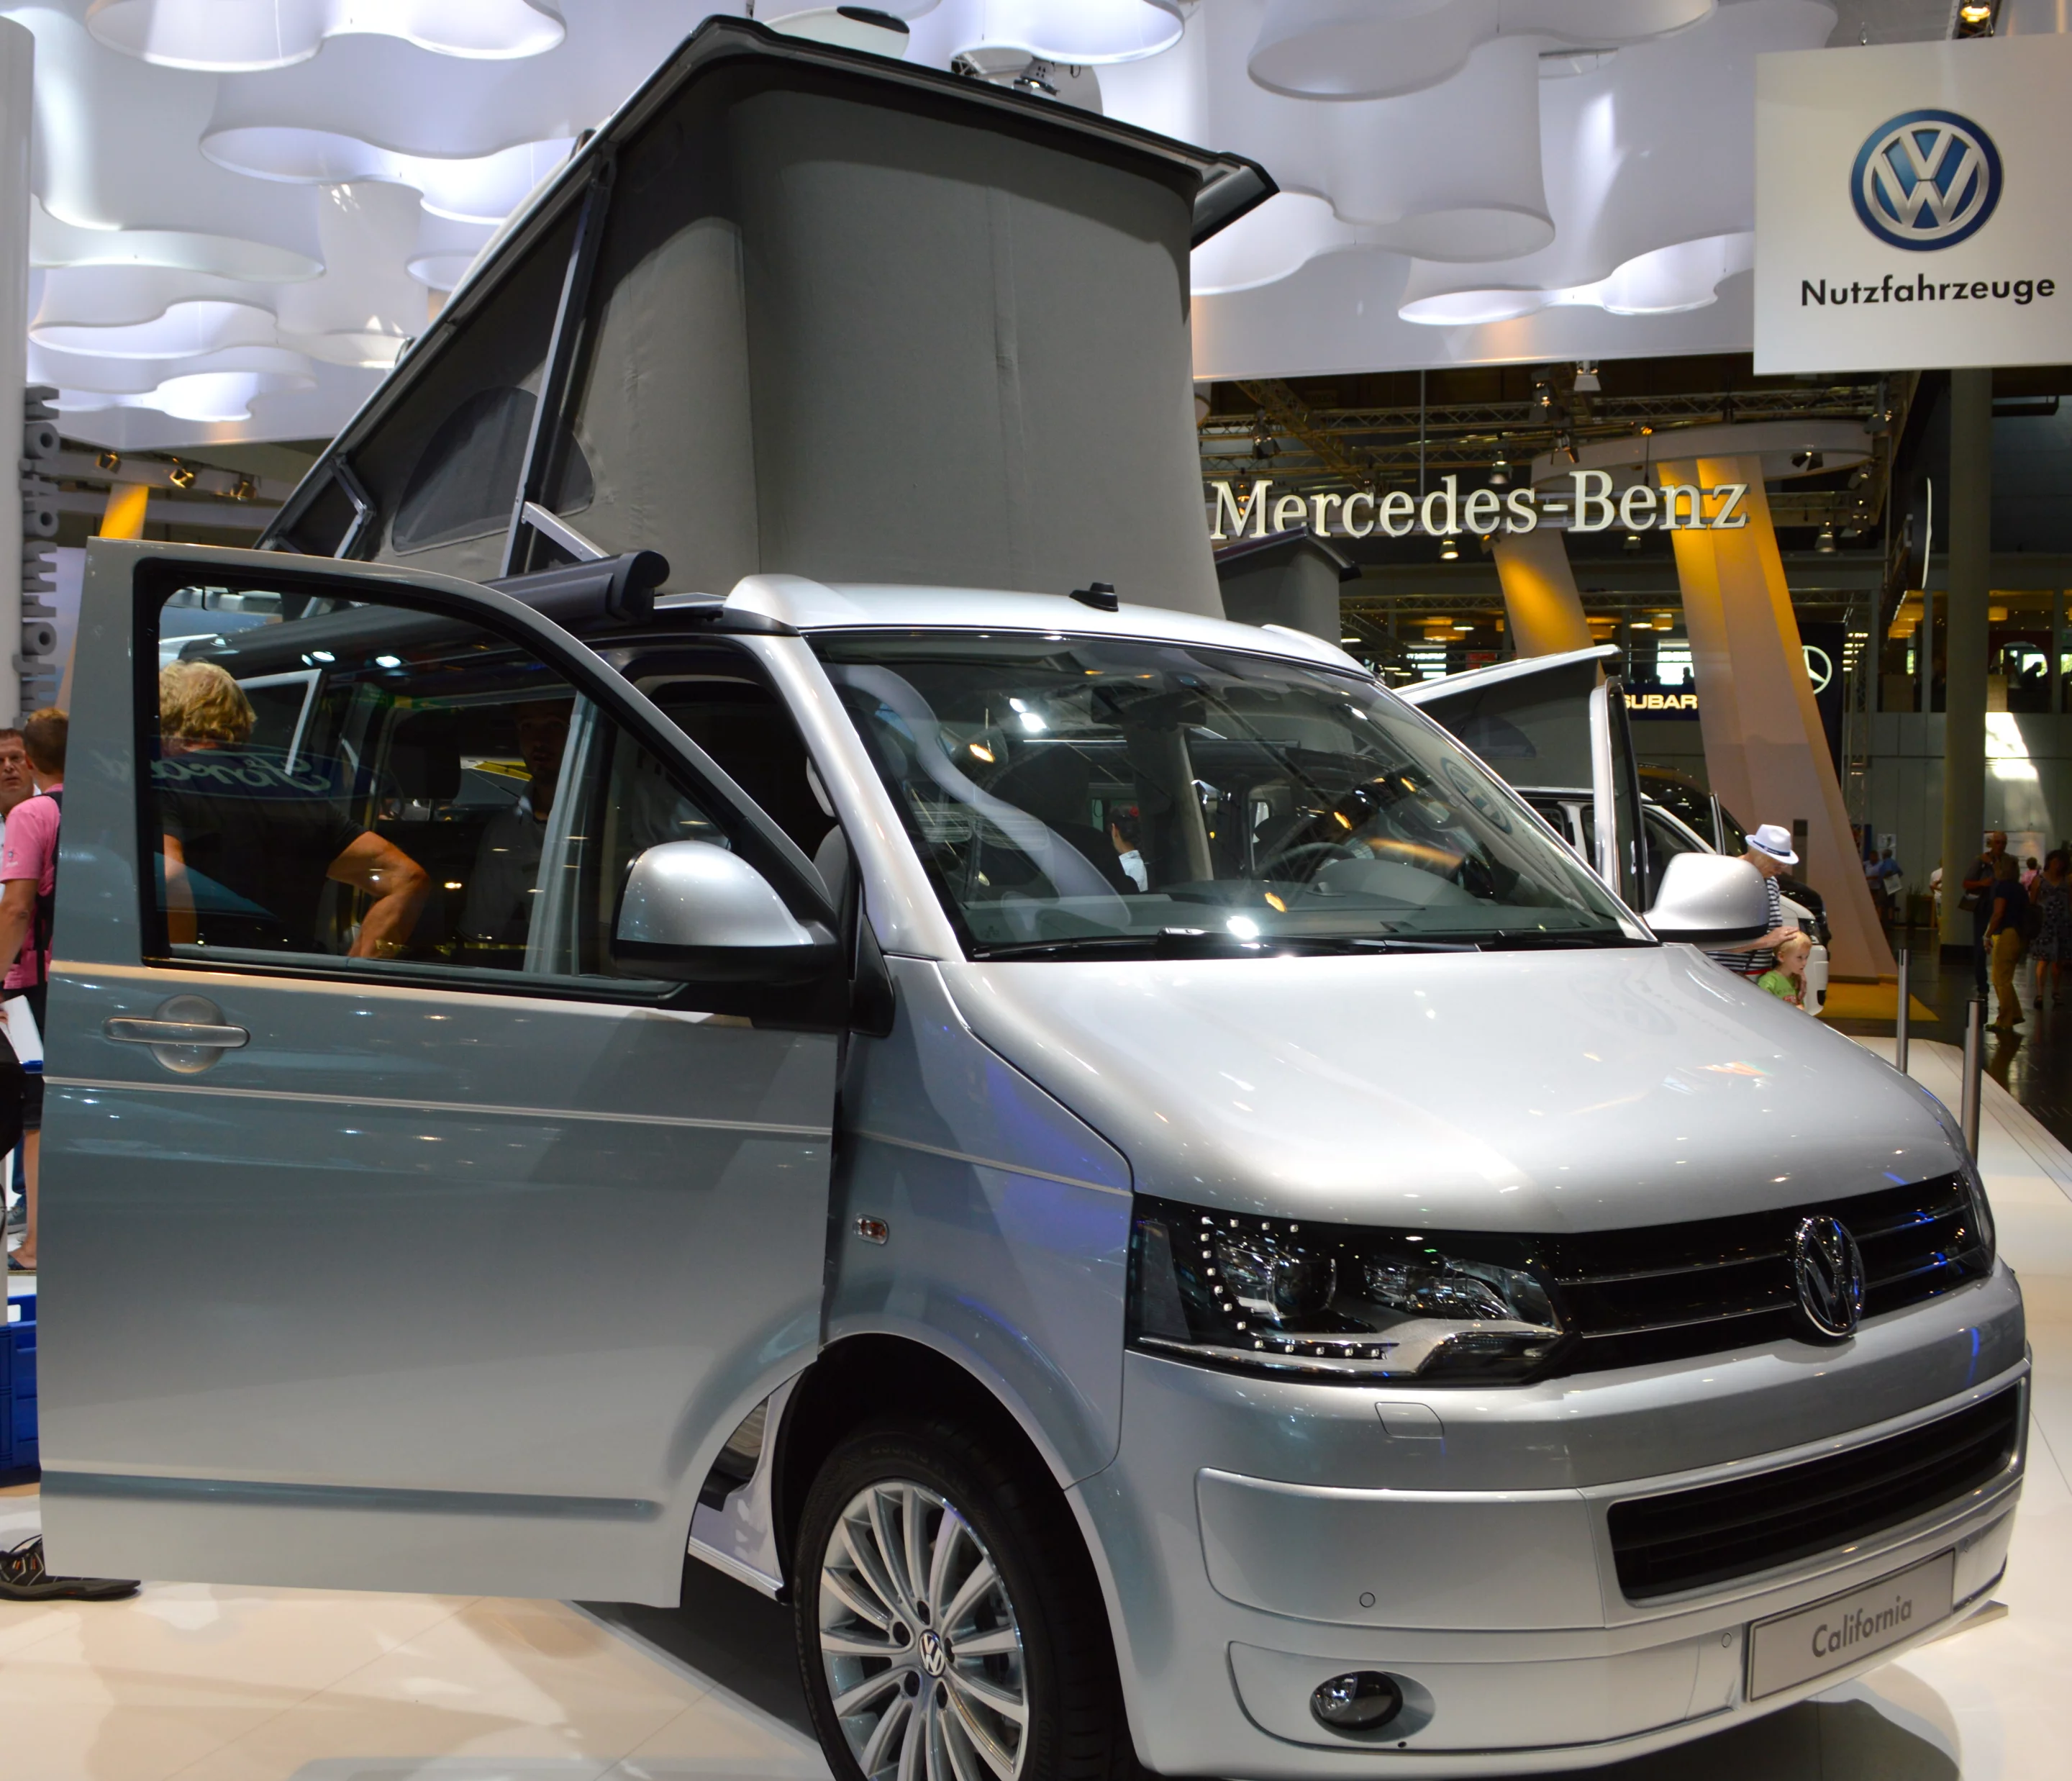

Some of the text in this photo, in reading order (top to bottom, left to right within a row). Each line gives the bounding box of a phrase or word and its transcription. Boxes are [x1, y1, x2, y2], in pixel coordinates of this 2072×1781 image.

[1801, 273, 2055, 306] Nutzfahrzeuge
[1210, 470, 1750, 540] Mercedes-Benz
[12, 386, 59, 729] nformation
[1812, 1595, 1913, 1657] California
